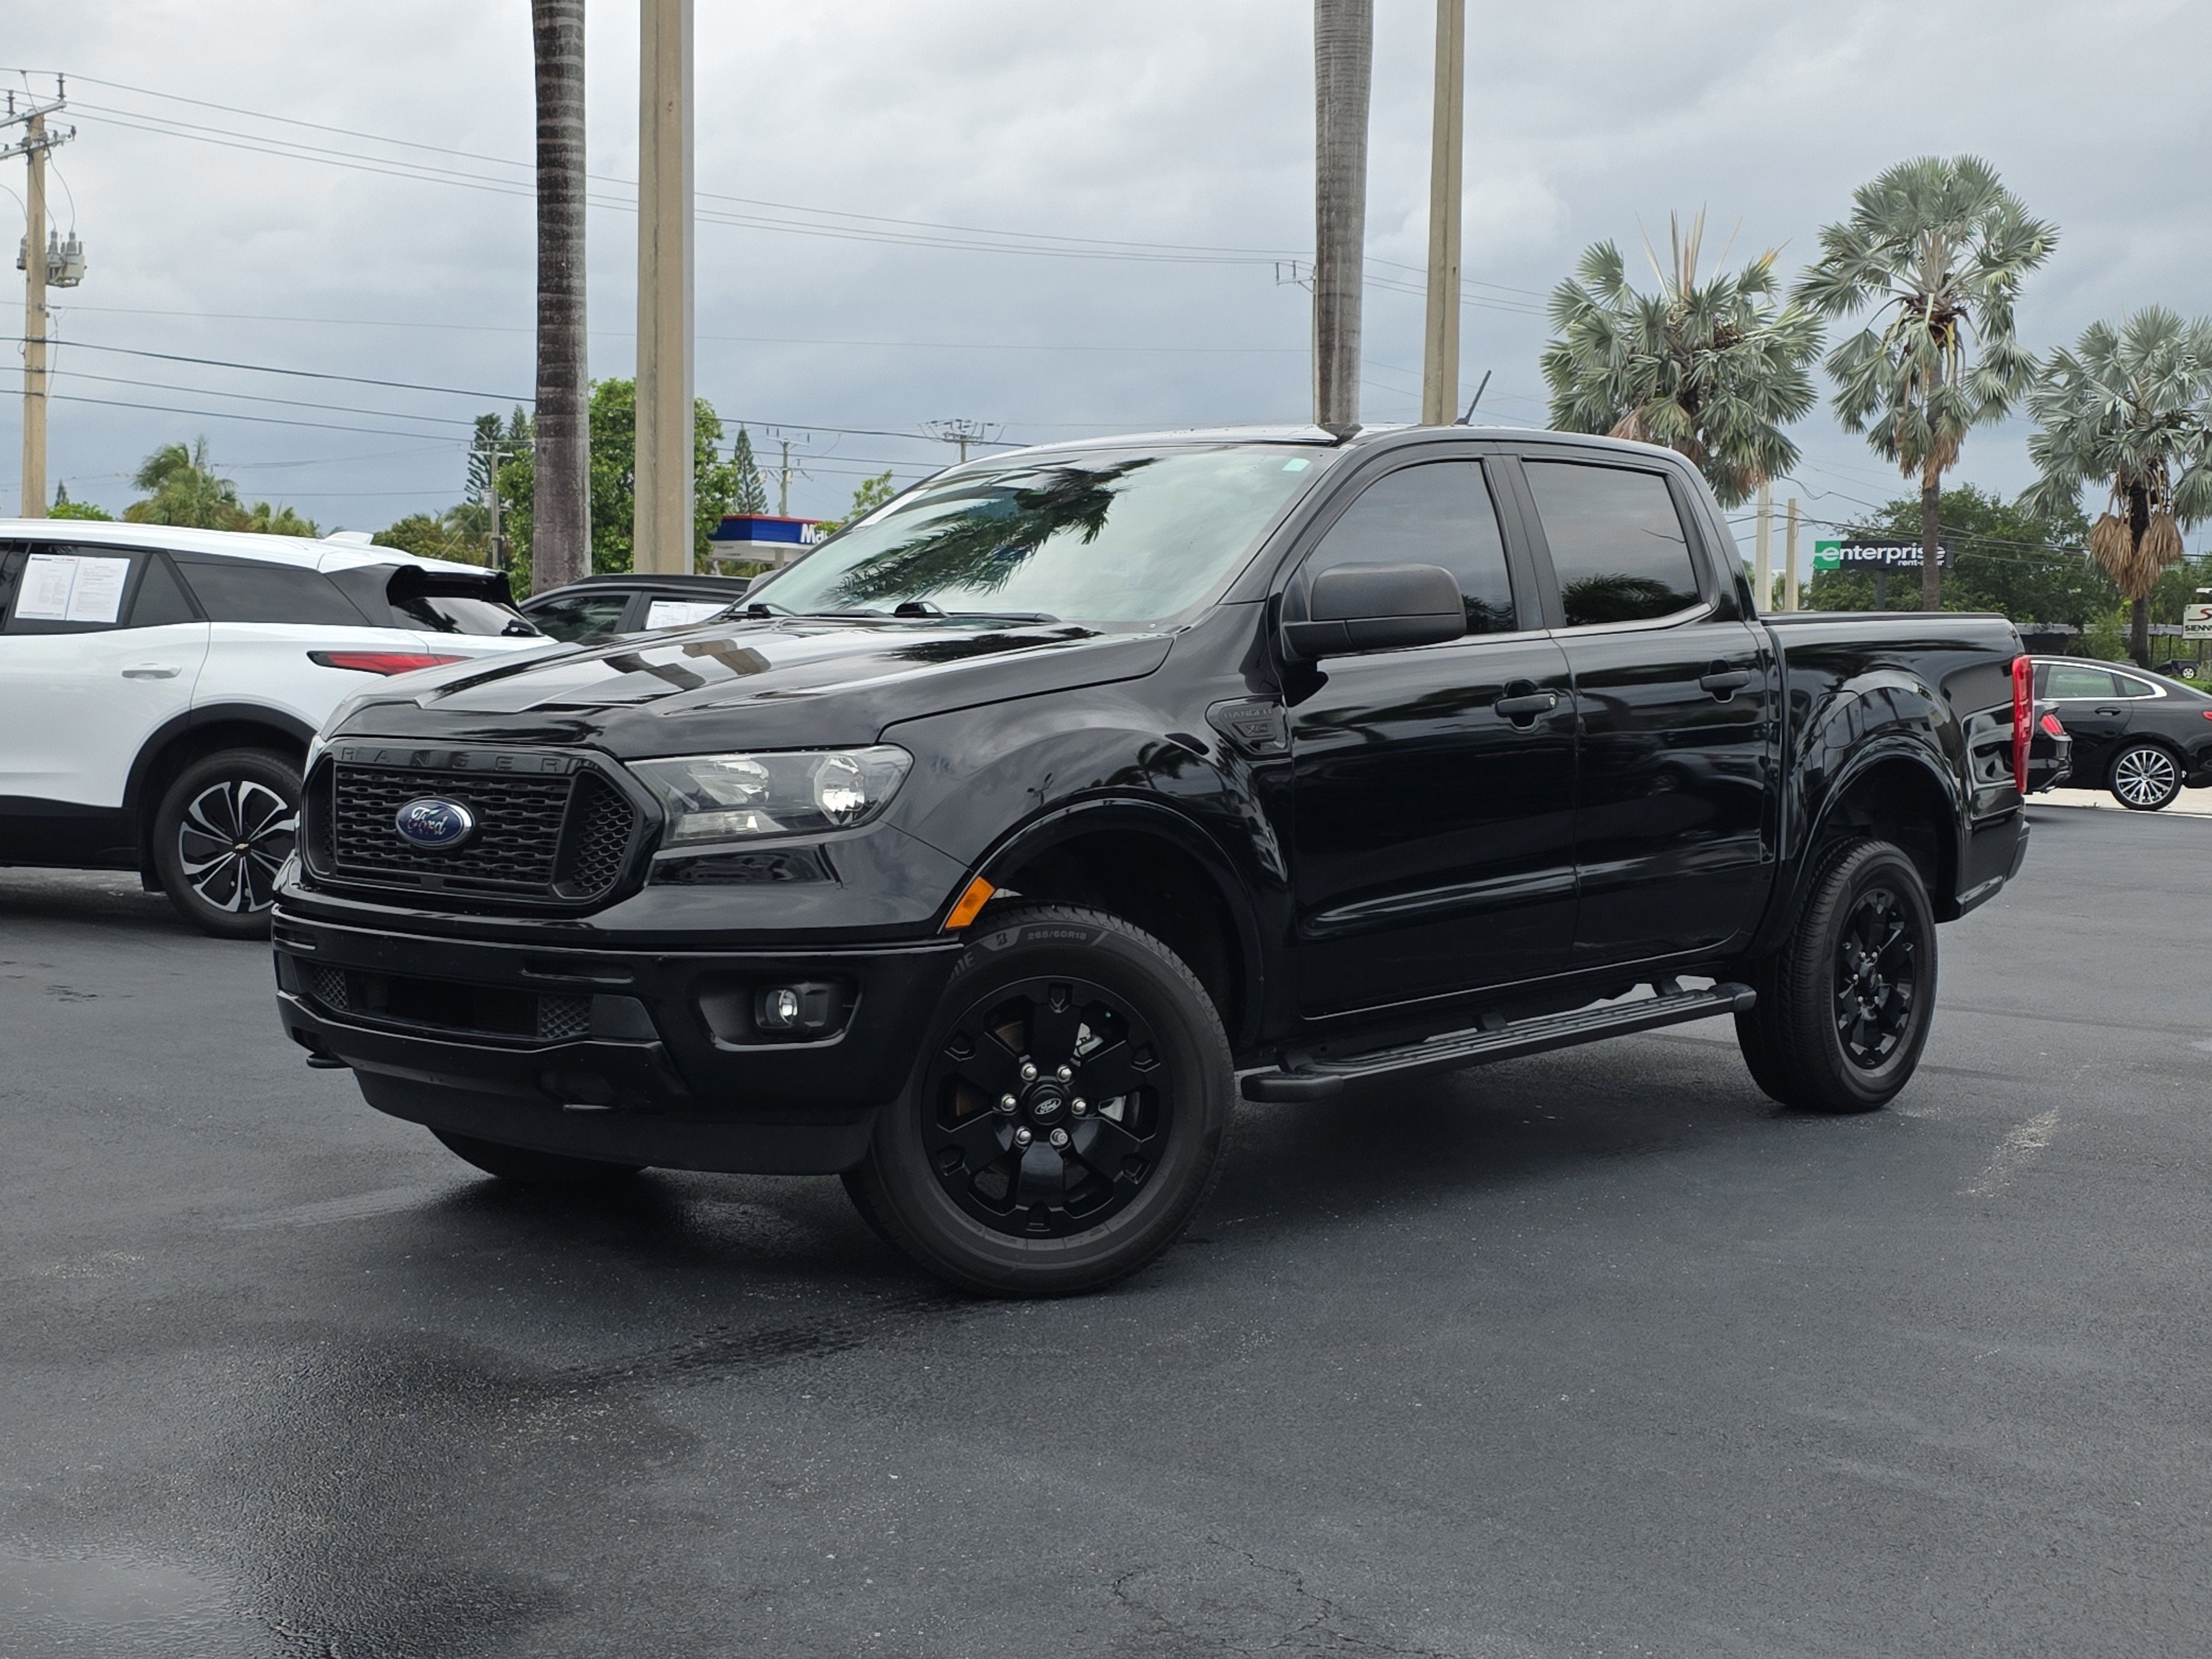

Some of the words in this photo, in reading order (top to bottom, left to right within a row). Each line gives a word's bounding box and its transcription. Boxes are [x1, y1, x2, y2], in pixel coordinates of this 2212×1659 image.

[801, 523, 829, 544] Ma
[341, 747, 562, 773] RANGER
[407, 805, 449, 837] Ford
[1028, 930, 1087, 941] 265/60R18
